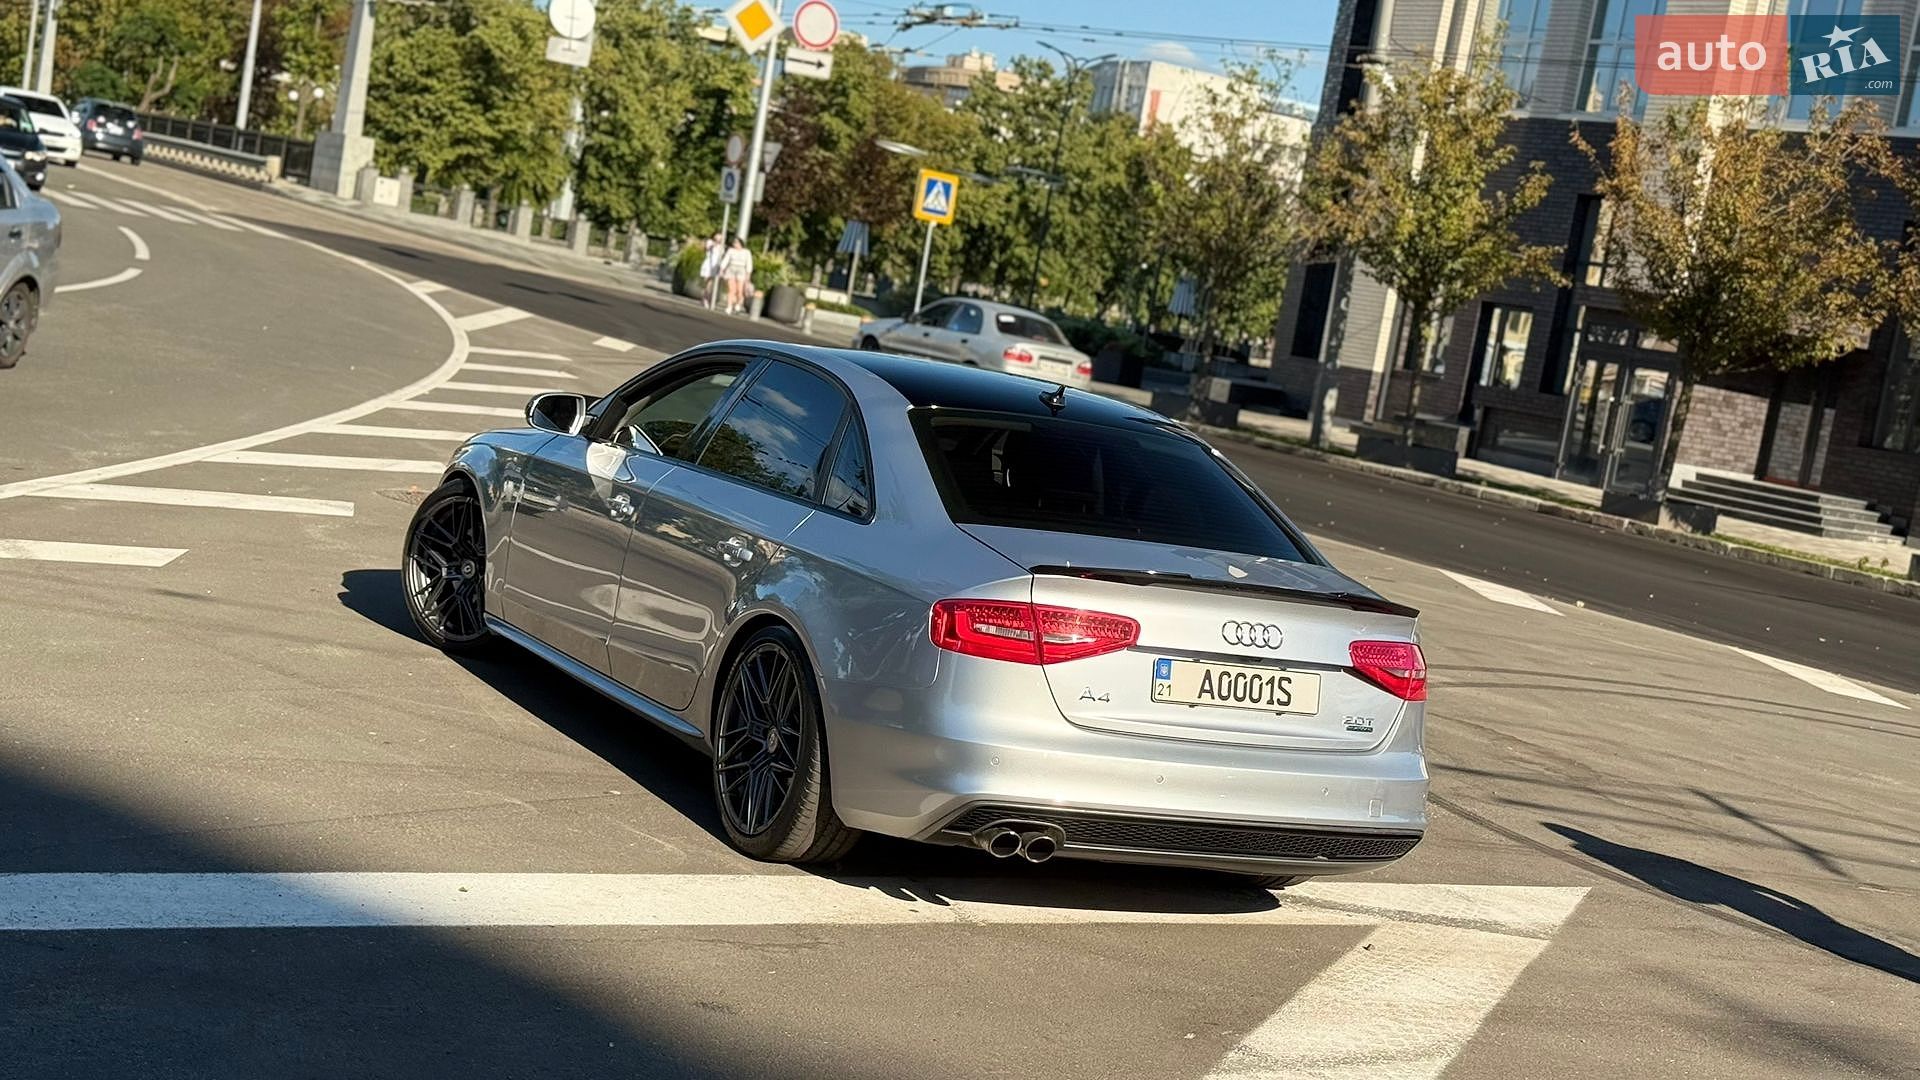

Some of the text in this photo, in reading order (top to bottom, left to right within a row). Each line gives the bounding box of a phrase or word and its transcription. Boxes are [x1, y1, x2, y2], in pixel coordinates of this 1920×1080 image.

[1079, 686, 1110, 703] A4
[1157, 683, 1171, 697] 21
[1197, 669, 1293, 707] A0001S
